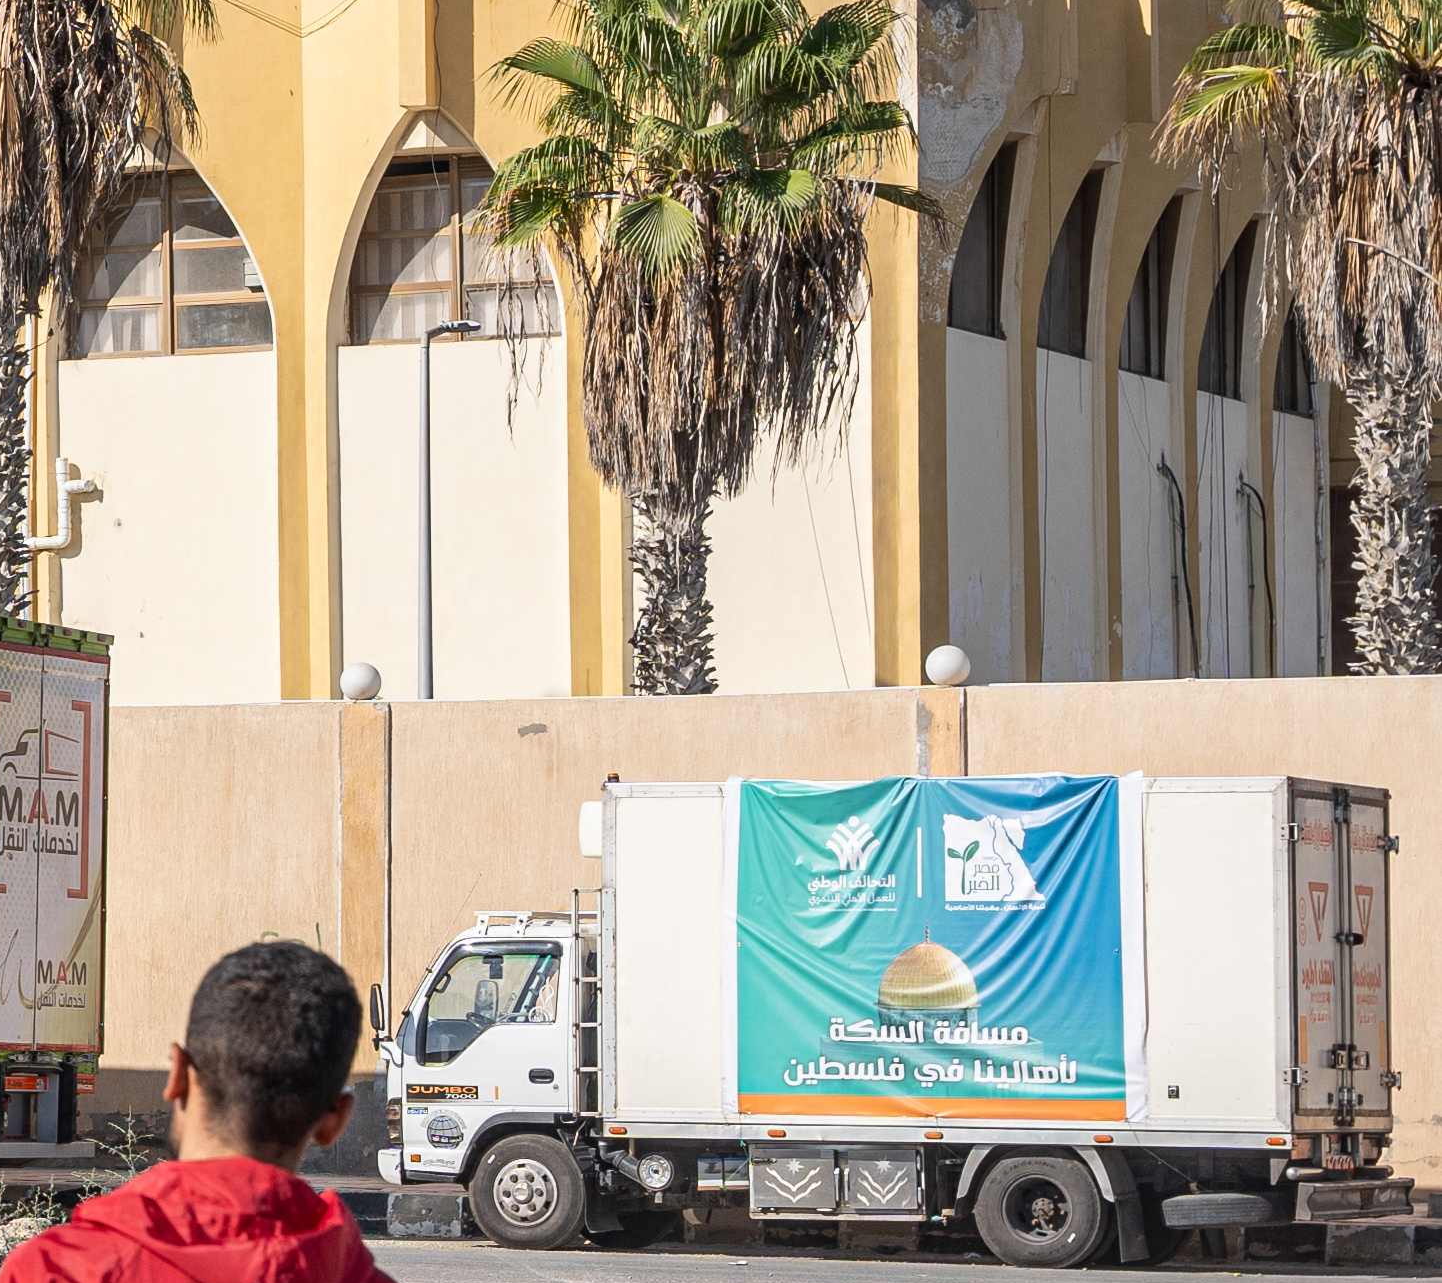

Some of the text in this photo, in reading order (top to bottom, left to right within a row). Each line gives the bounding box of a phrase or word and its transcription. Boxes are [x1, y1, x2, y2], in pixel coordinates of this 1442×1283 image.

[32, 828, 80, 856] لخدمات
[973, 863, 1000, 878] مصر
[807, 873, 896, 895] التحالف الوطني
[966, 874, 1000, 896] الخير
[37, 958, 88, 986] M.A.M
[829, 1016, 1029, 1046] مسافة السكة
[783, 1054, 1078, 1089] لأهالينا في فلسطين
[408, 1085, 477, 1094] JUMBO
